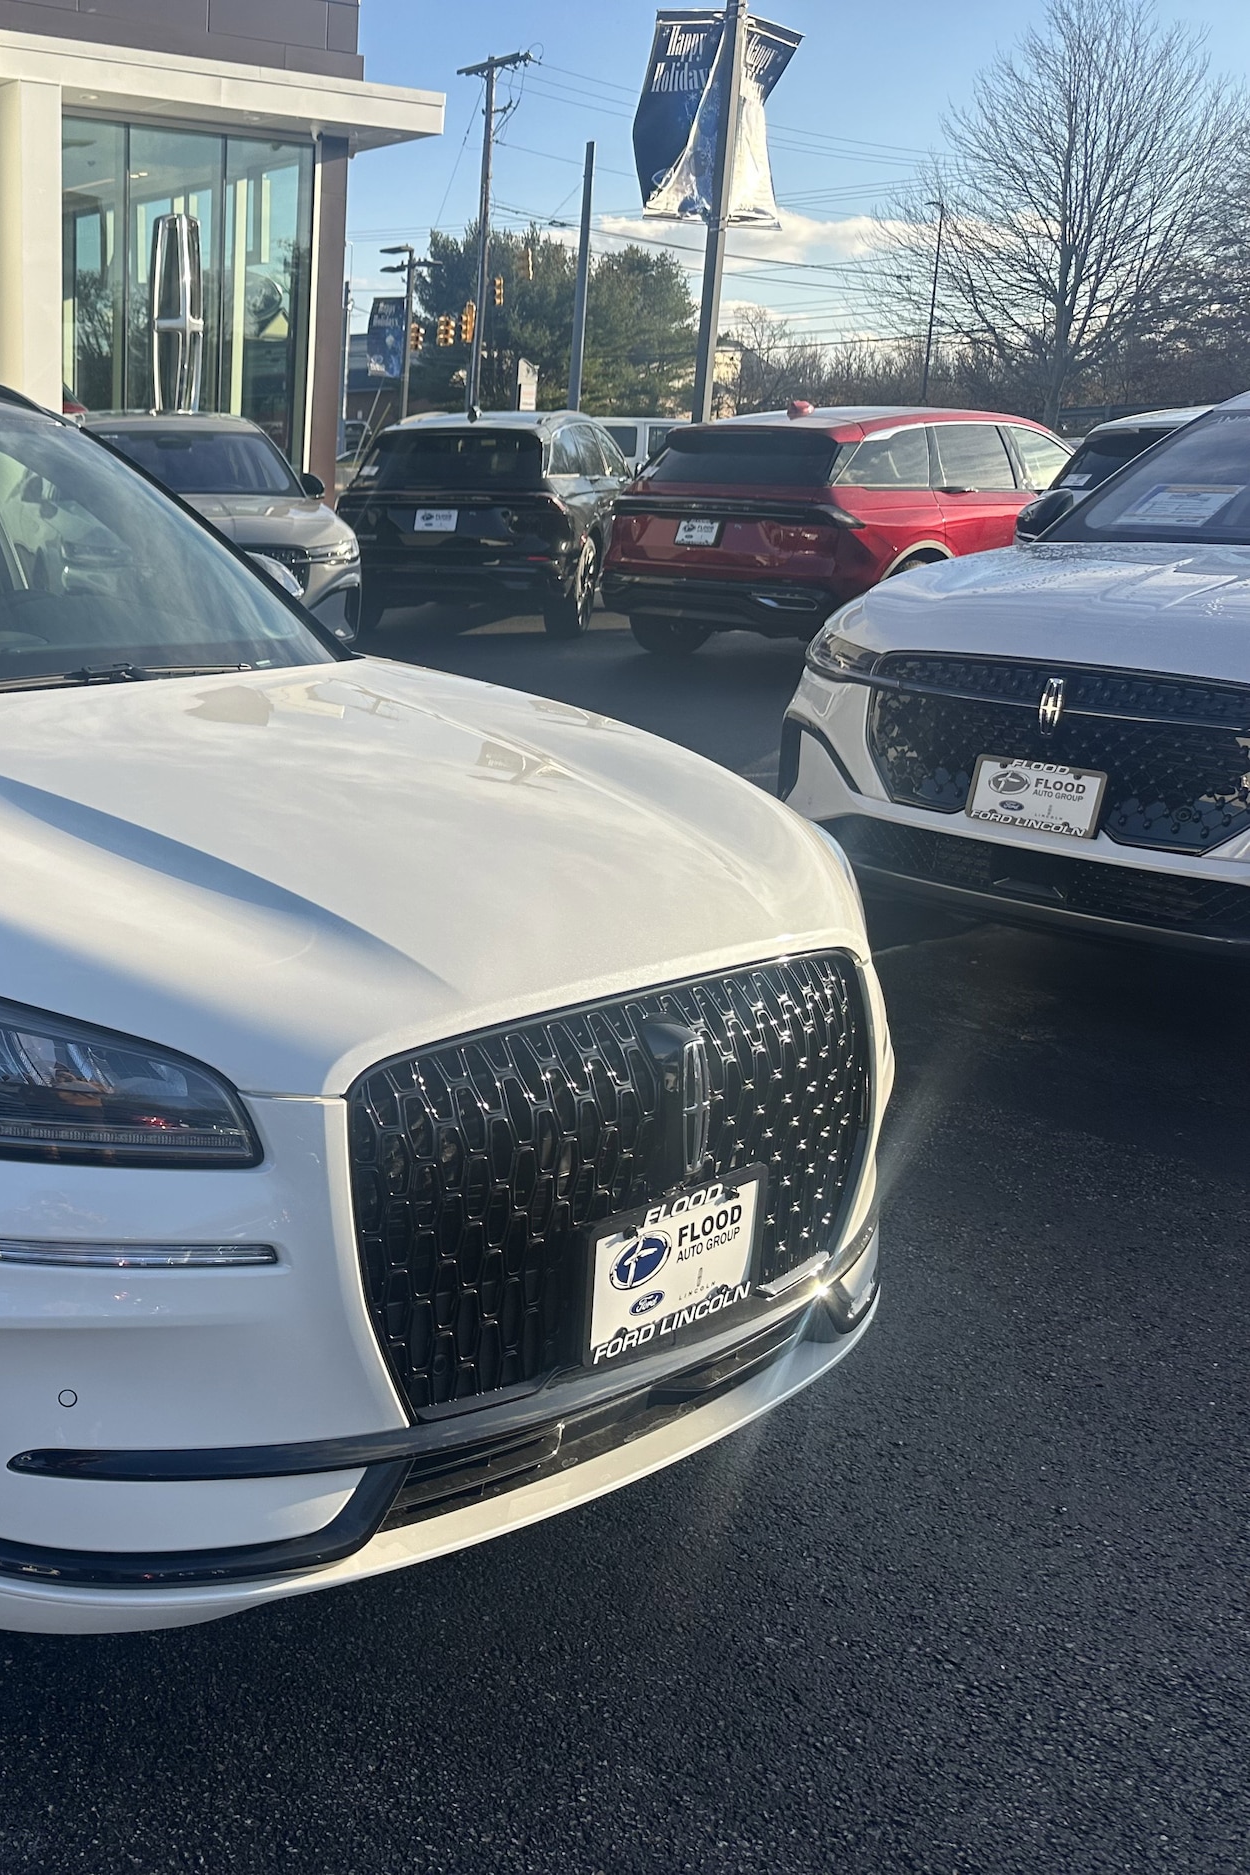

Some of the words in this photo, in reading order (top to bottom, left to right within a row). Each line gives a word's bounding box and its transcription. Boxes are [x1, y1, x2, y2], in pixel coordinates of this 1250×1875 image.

[666, 25, 707, 62] Happy
[745, 34, 778, 75] Happy
[651, 62, 711, 94] Holiday
[1011, 759, 1070, 775] FLOOD
[1032, 789, 1054, 799] AUTO
[1055, 793, 1084, 803] GROUP
[1034, 777, 1086, 794] FLOOD
[970, 810, 1013, 824] FORD
[1014, 817, 1086, 837] LINCOLN
[644, 1183, 724, 1227] FLOOD
[677, 1204, 742, 1247] FLOOD
[676, 1242, 704, 1264] AUTO
[706, 1226, 741, 1252] GROUP
[678, 1281, 717, 1301] LINCOLN
[592, 1323, 656, 1365] FORD
[659, 1281, 751, 1335] LINCOLN
